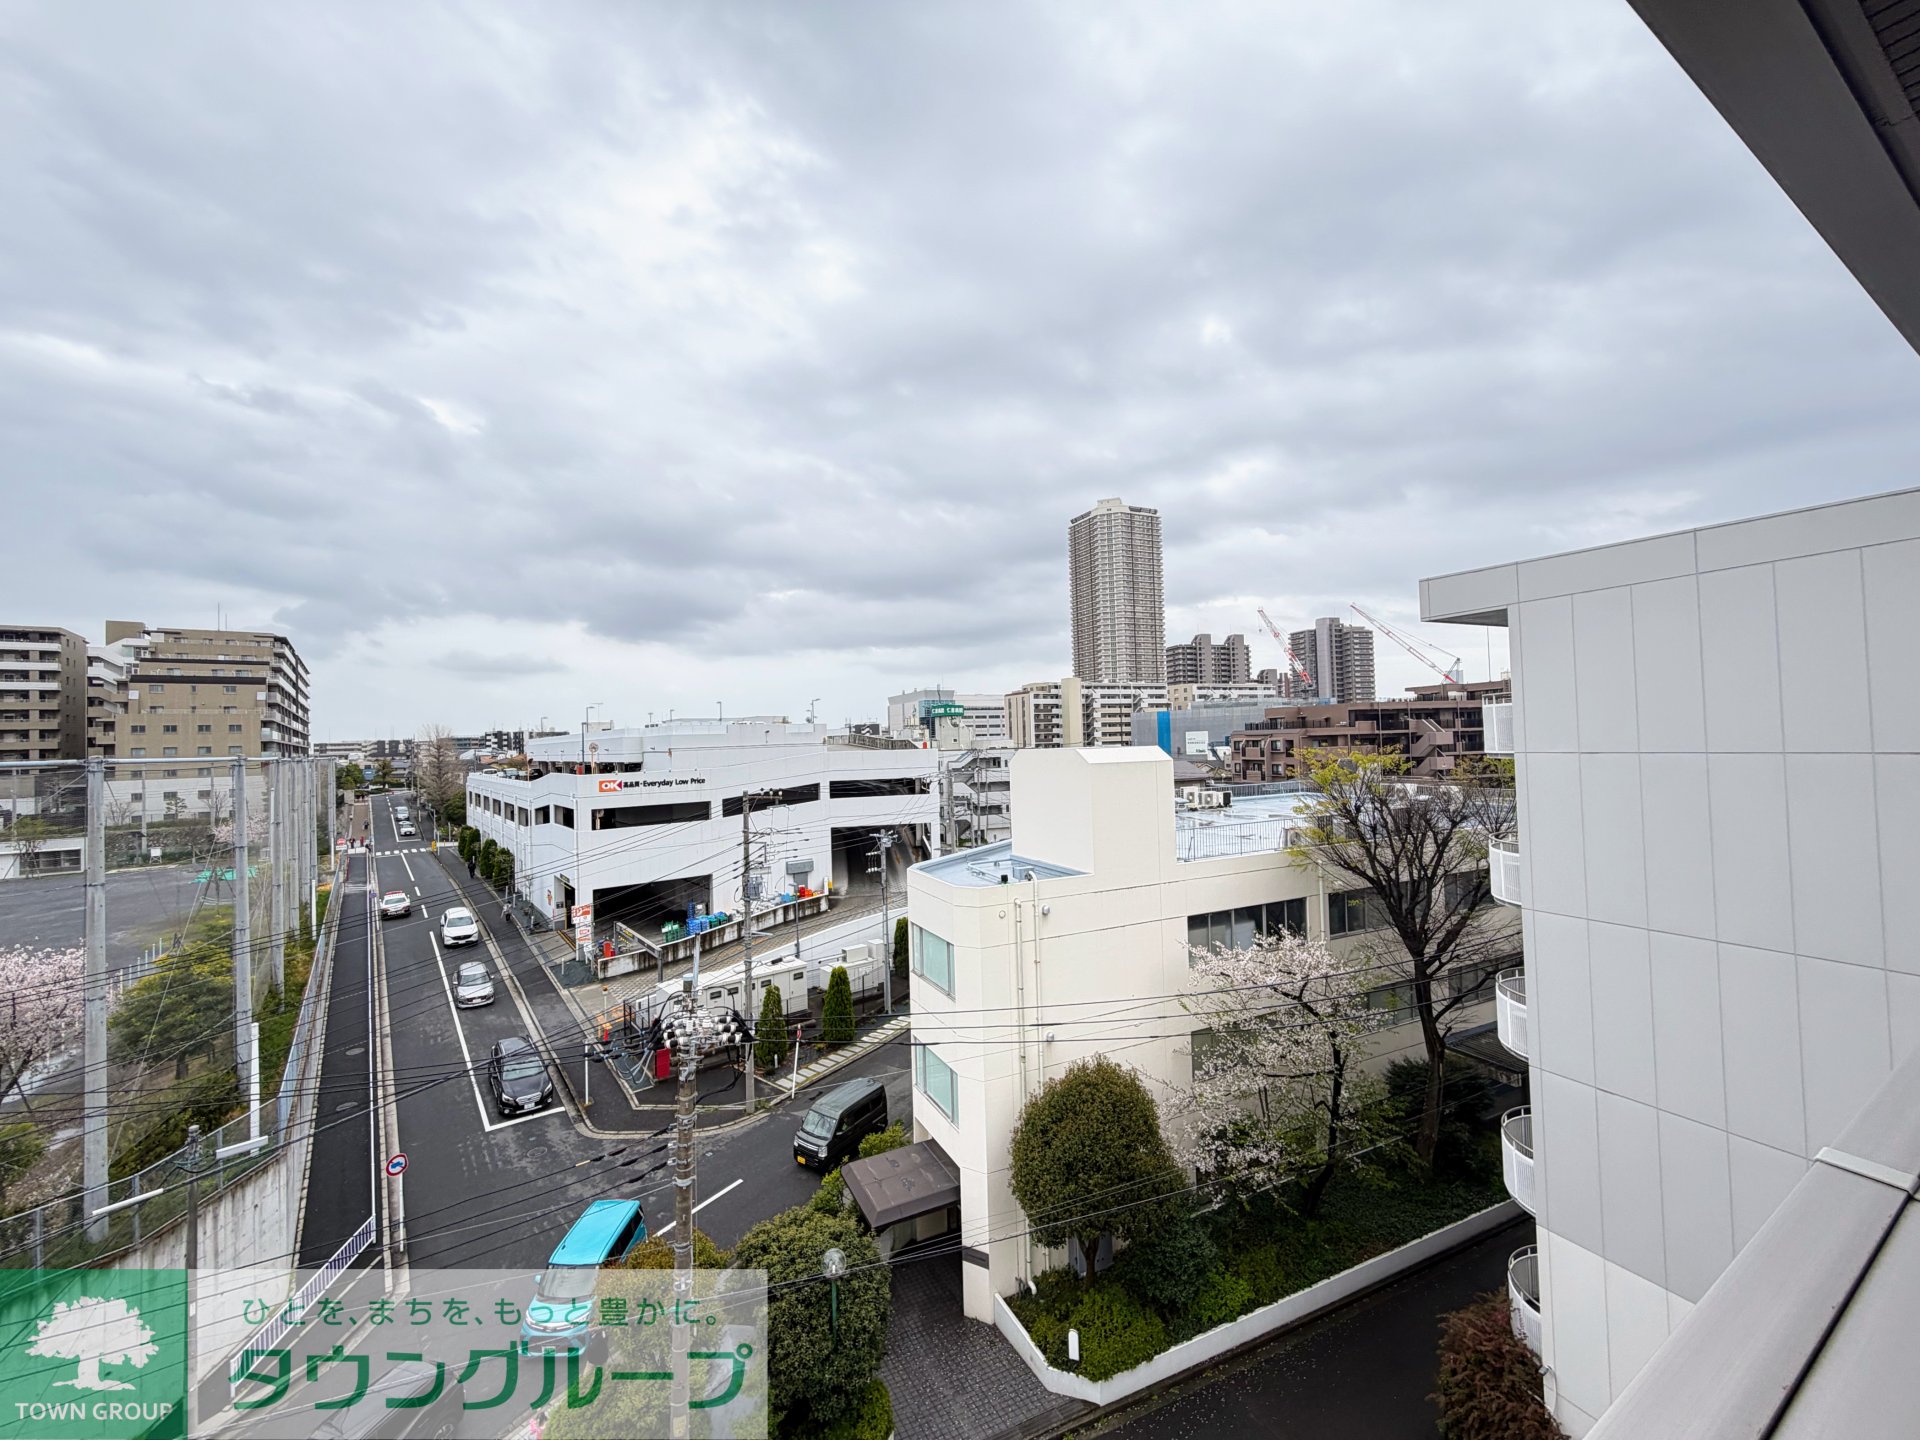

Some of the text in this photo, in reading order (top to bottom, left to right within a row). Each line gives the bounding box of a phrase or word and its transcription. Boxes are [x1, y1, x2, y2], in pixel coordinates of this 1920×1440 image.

[600, 780, 622, 791] OK
[675, 778, 688, 786] Low
[690, 777, 706, 785] Price
